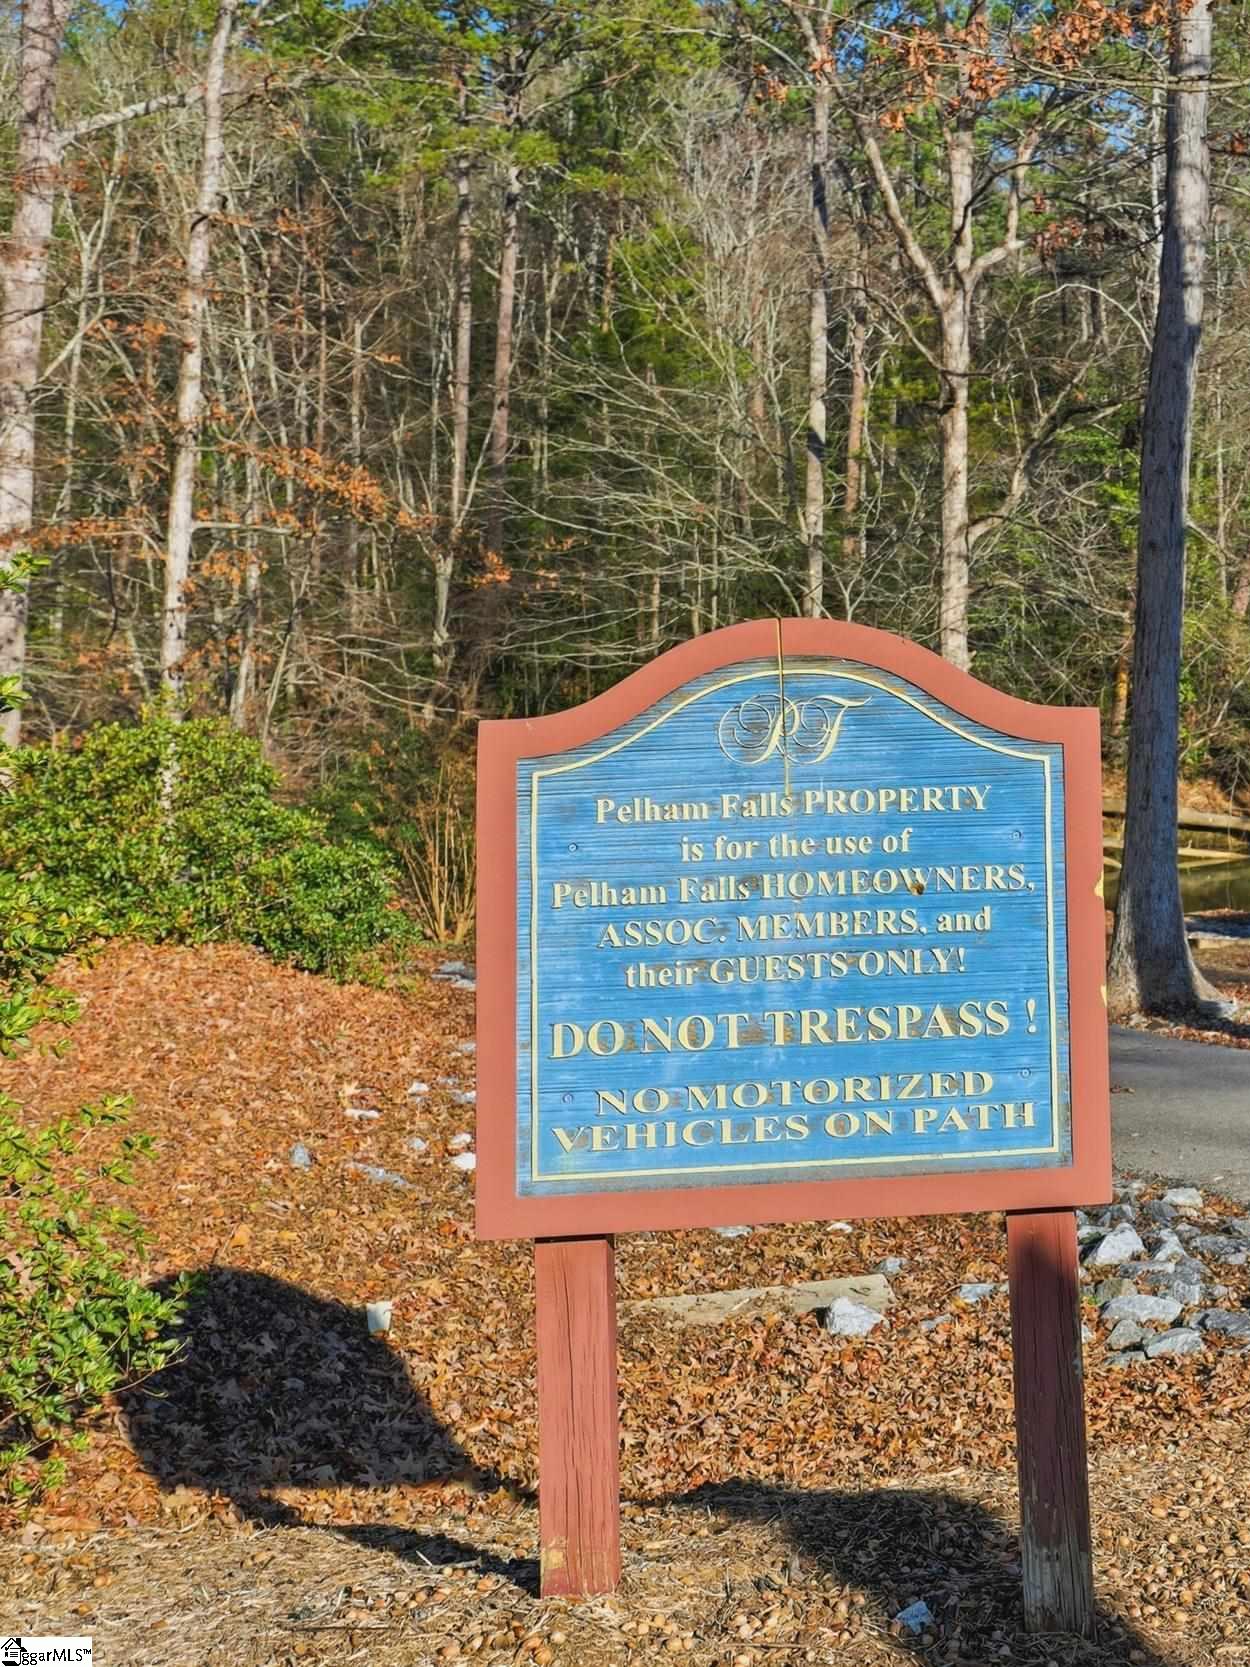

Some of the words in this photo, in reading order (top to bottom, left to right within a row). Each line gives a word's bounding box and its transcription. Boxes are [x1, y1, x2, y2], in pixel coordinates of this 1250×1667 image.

[596, 796, 710, 824] Pelham
[720, 792, 793, 819] Falls
[804, 784, 992, 815] PROPERTY
[681, 837, 704, 862] is
[714, 834, 758, 860] for
[769, 832, 815, 858] the
[826, 834, 870, 856] use
[882, 827, 914, 853] of
[552, 882, 669, 908] Pelham
[679, 876, 750, 903] Falls
[762, 862, 1036, 899] HOMEOWNERS,
[597, 915, 726, 948] ASSOC.
[737, 909, 928, 942] MEMBERS,
[936, 905, 992, 932] and
[626, 962, 698, 988] their
[710, 952, 849, 985] GUESTS
[858, 947, 966, 978] ONLY!
[549, 1018, 626, 1060] DO
[639, 1013, 752, 1055] NOT
[764, 999, 1009, 1047] TRESPASS
[1024, 998, 1038, 1034] !
[596, 1087, 671, 1116] NO
[686, 1070, 994, 1111] MOTORIZED
[552, 1113, 809, 1155] VEHICLES
[825, 1109, 897, 1139] ON
[911, 1101, 1036, 1133] PATH
